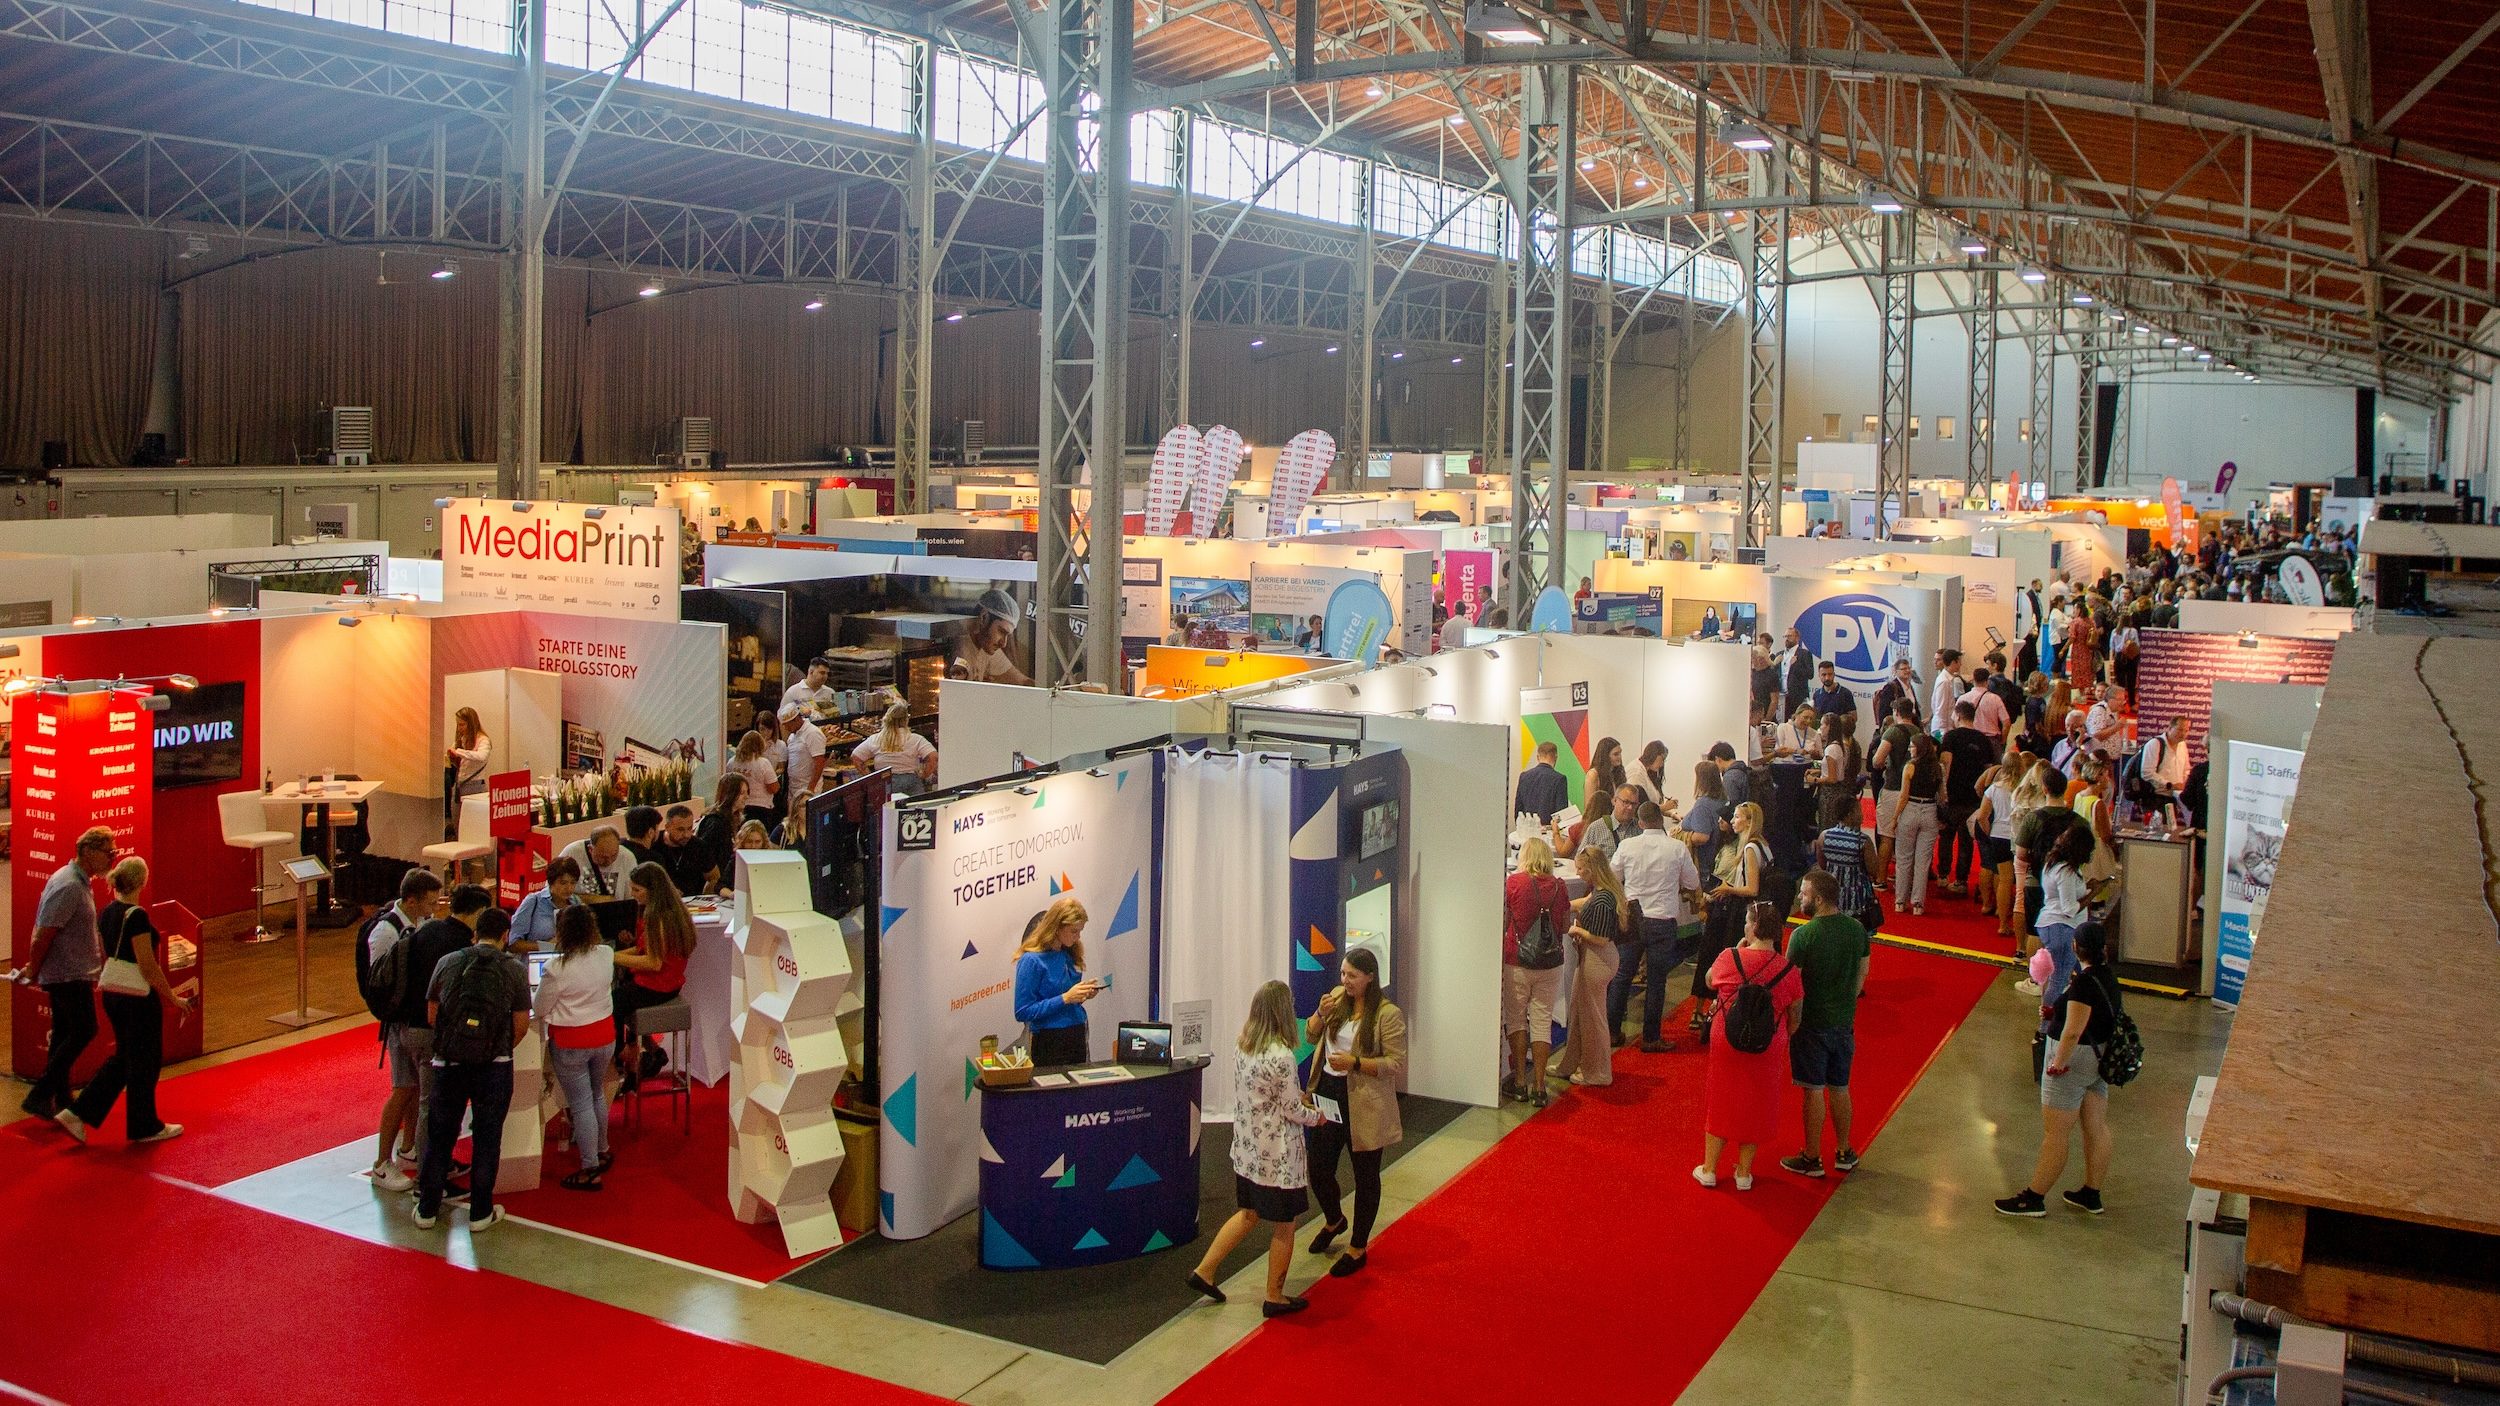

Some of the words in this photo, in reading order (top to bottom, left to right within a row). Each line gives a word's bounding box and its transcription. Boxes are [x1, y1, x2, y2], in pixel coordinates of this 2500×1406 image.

[460, 514, 664, 568] MediaPrint
[565, 576, 594, 584] KURIER
[539, 639, 583, 656] STARTE
[588, 643, 626, 659] DEINE
[1822, 613, 1889, 672] PV
[539, 657, 638, 679] ERFOLGSSTORY
[1173, 678, 1196, 694] Wir
[1574, 688, 1586, 700] 03
[154, 726, 191, 748] IND
[192, 721, 234, 743] WIR
[89, 747, 115, 755] KRONE
[115, 743, 135, 752] BUNT
[103, 762, 135, 776] krone.at
[492, 786, 528, 803] Kronen
[1354, 780, 1368, 795] HAYS
[26, 809, 55, 821] KURIER
[92, 806, 134, 820] KURIER
[492, 802, 528, 819] Zeitung
[902, 819, 932, 840] 02
[954, 813, 984, 834] HAYS
[954, 847, 1003, 878] CREATE
[500, 879, 520, 891] Kronen
[954, 865, 1038, 906] TOGETHER.
[500, 888, 520, 901] Zeitung
[950, 978, 1011, 1012] hayscareer.net
[1065, 1111, 1110, 1128] HAYS
[775, 1135, 789, 1154] ÖB
